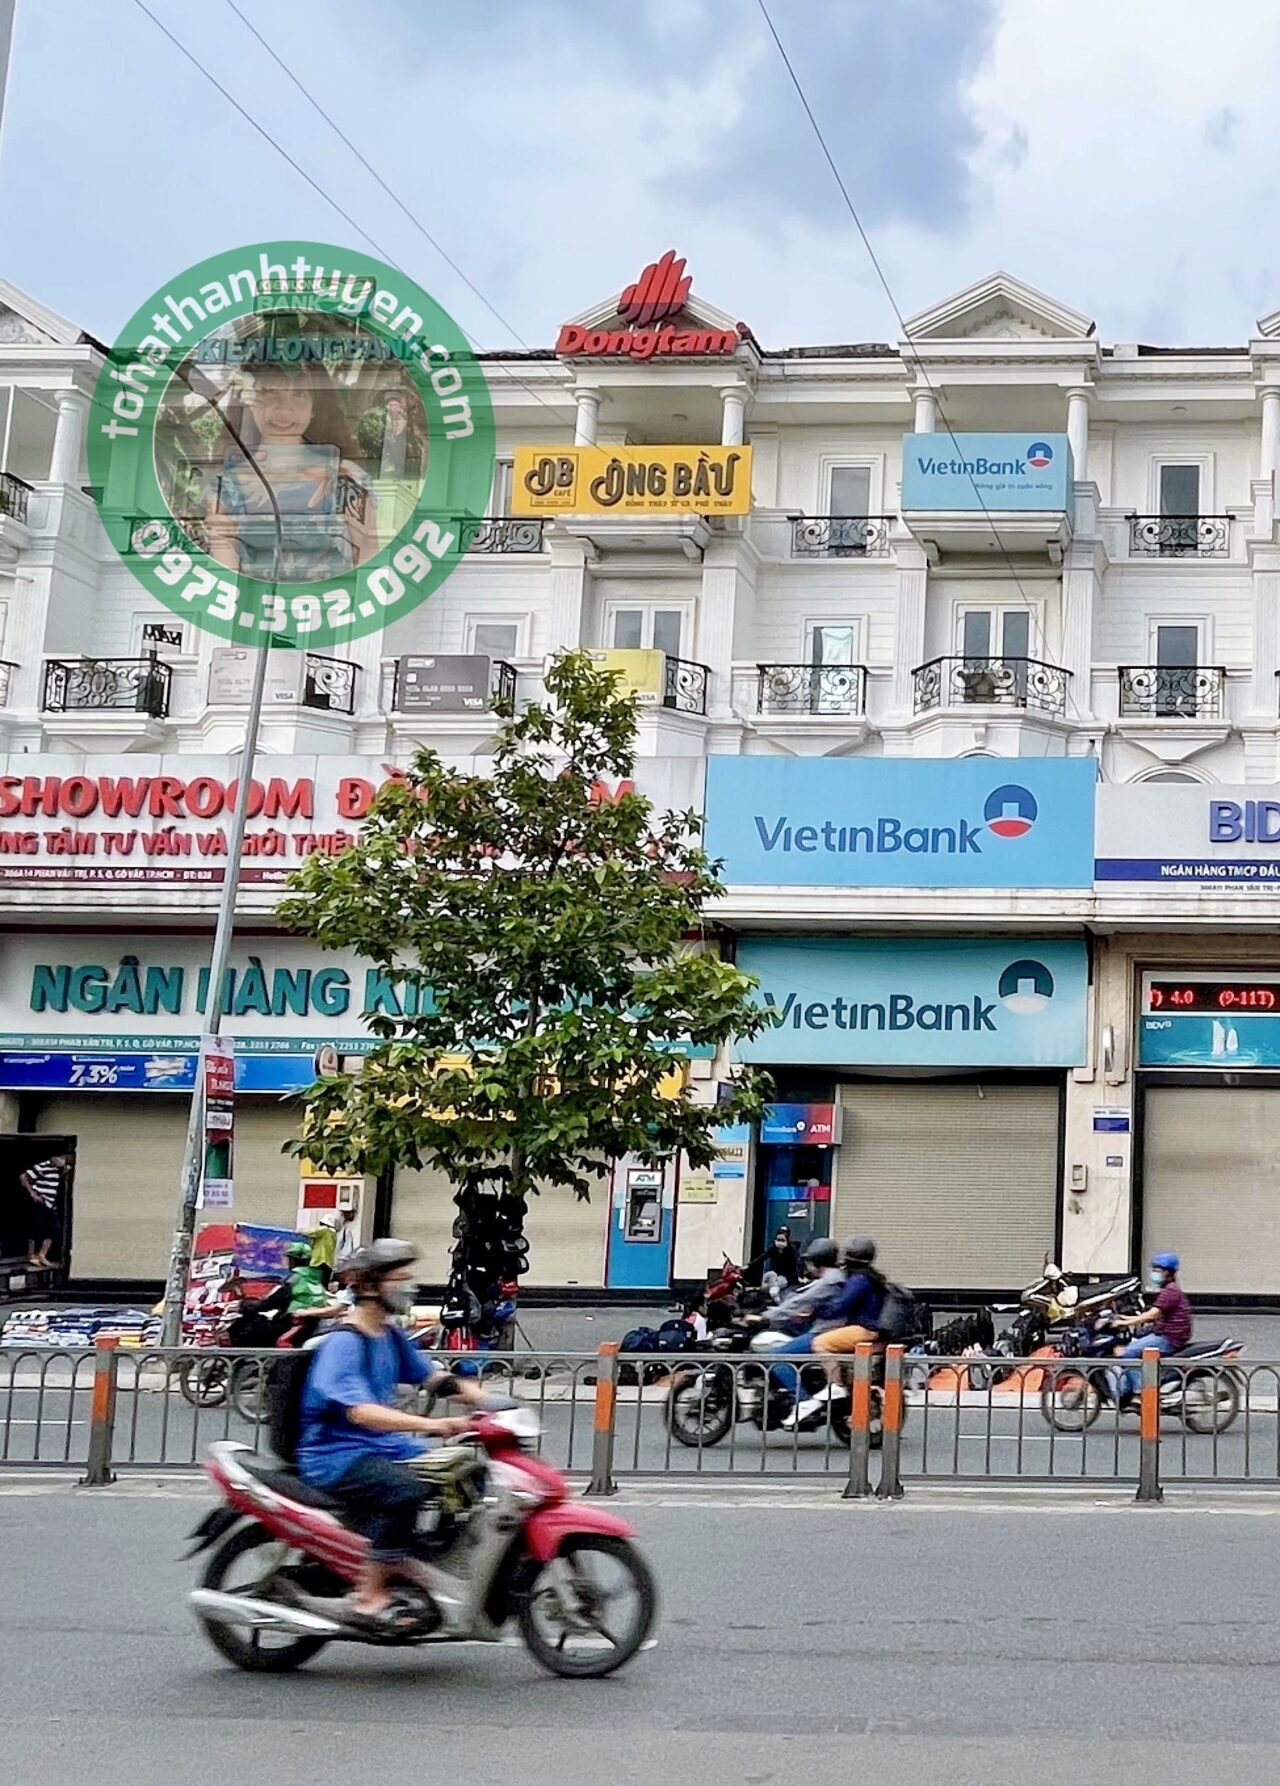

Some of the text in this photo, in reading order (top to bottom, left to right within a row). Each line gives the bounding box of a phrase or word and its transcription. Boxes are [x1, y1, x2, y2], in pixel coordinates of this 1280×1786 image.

[917, 457, 1027, 475] VietinBank
[463, 696, 484, 706] VISA
[0, 775, 314, 819] SHOWROOM
[43, 828, 95, 855] TÂM
[101, 829, 138, 855] TƯ
[195, 827, 228, 856] VÀ
[753, 815, 983, 854] VietinBank
[1161, 864, 1193, 877] NGÂN
[1194, 863, 1227, 877] HÀNG
[1228, 866, 1258, 877] TMCP
[30, 955, 185, 1015] NGÂN
[195, 956, 351, 1017] HÀNG
[1170, 990, 1194, 1005] 4.0
[763, 992, 998, 1032] VietinBank
[810, 1123, 832, 1134] ATM
[635, 1174, 656, 1183] ATM
